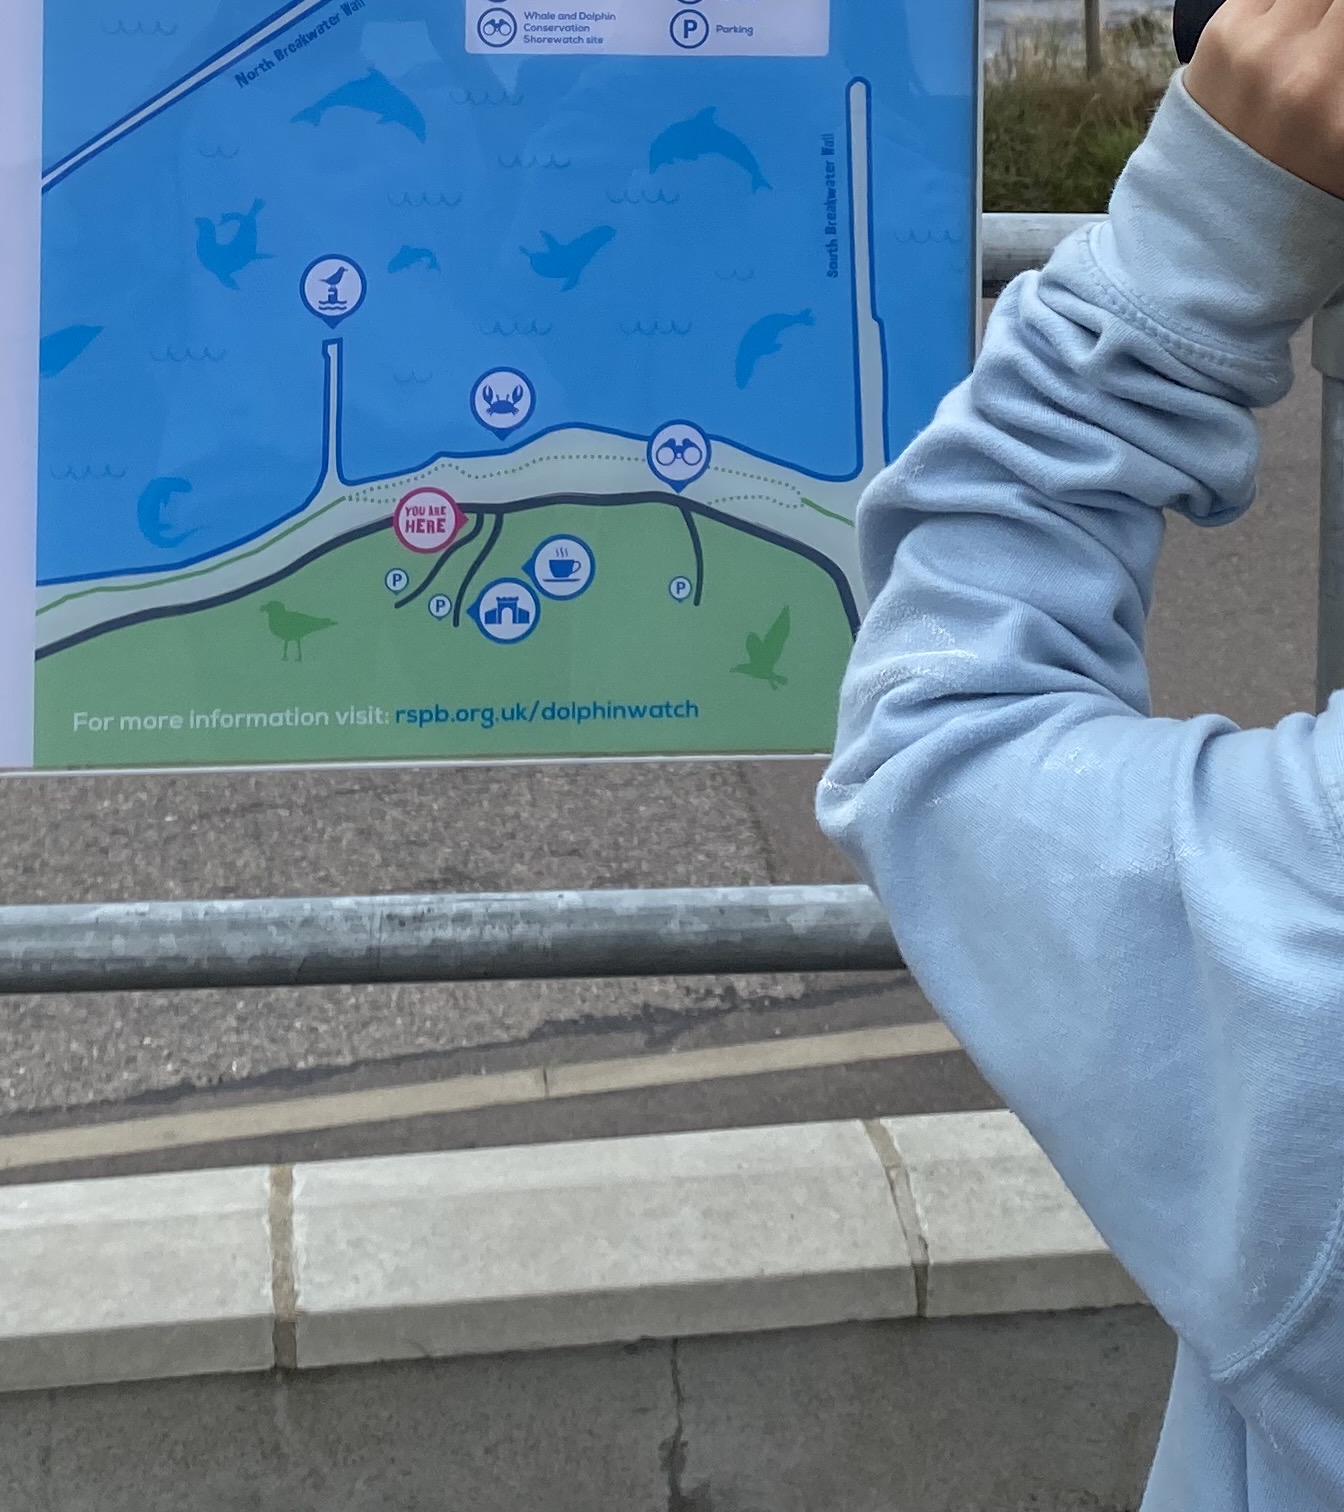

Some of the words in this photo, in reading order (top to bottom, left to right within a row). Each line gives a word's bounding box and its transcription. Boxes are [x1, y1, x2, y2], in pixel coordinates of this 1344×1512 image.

[523, 11, 556, 21] Whale
[558, 12, 577, 21] and
[579, 12, 617, 23] Dolphin
[523, 23, 591, 33] Conservation
[683, 19, 698, 39] P
[716, 24, 754, 36] Parking
[523, 35, 585, 44] Shorewatch
[586, 35, 604, 44] site
[234, 58, 276, 88] North
[273, 14, 341, 63] Breakwater
[823, 160, 838, 235] Breakwater
[825, 239, 838, 278] South
[405, 506, 426, 517] YOU
[428, 505, 447, 517] ARE
[405, 518, 447, 534] HERE
[392, 573, 402, 586] P
[676, 581, 686, 594] P
[435, 599, 446, 613] P
[74, 712, 114, 731] For
[120, 715, 183, 730] more
[190, 707, 329, 729] information
[335, 705, 389, 725] visit:
[396, 700, 698, 729] rspb.org.uk/dolphinwatch
